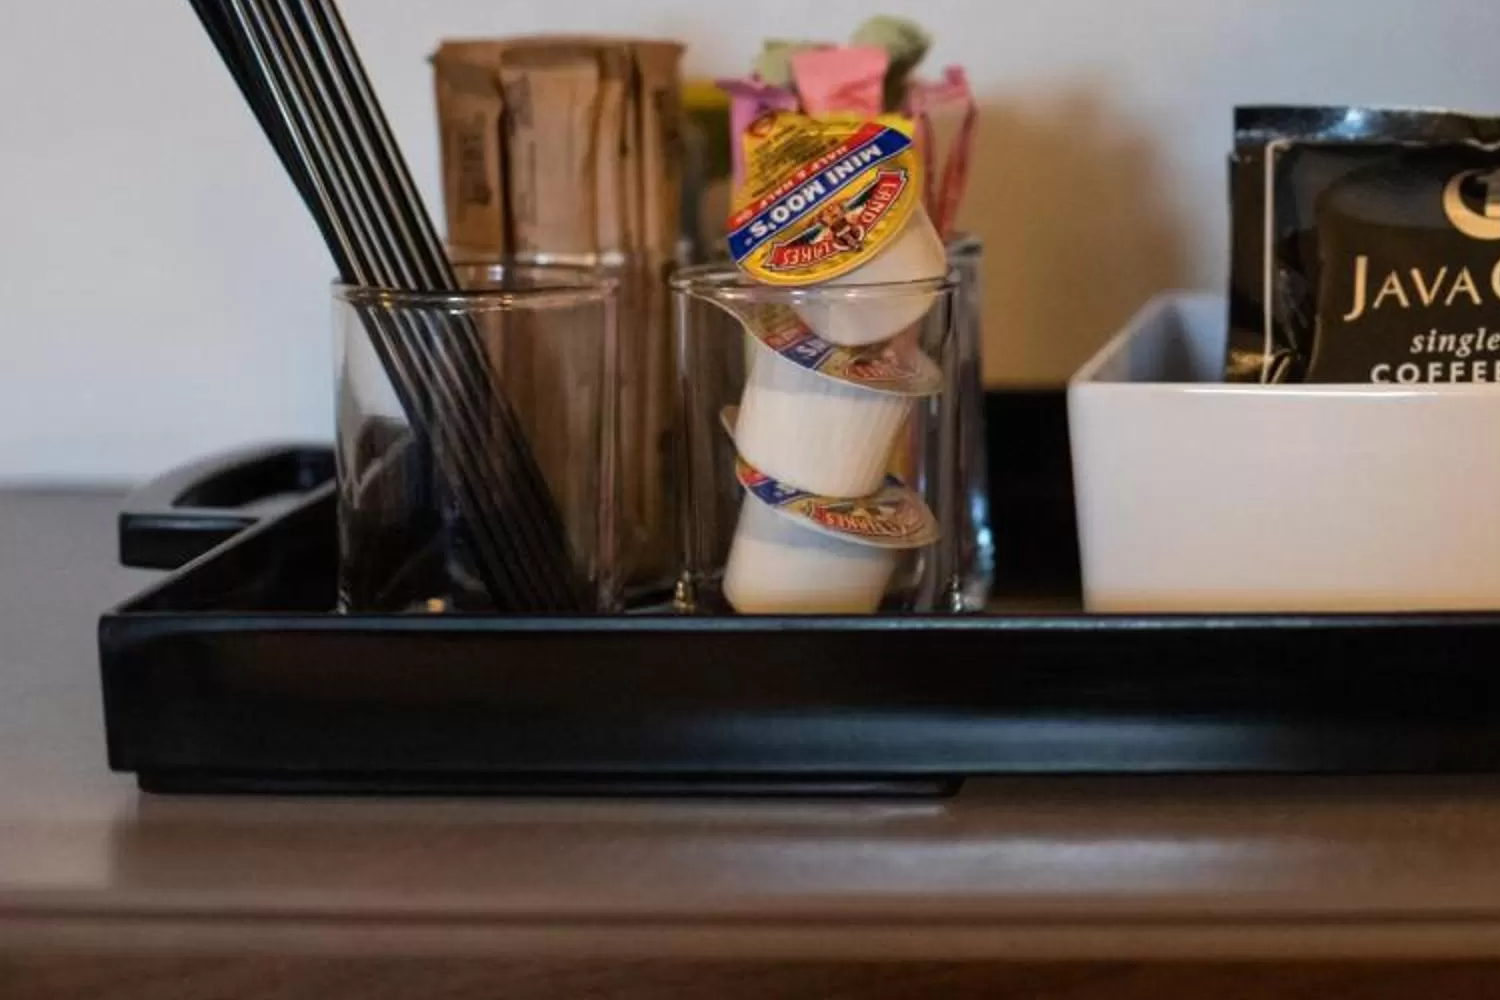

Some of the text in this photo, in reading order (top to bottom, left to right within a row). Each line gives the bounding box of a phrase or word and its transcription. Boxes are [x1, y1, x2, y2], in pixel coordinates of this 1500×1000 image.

[827, 144, 883, 186] MINI
[782, 181, 898, 265] LAND LAKES
